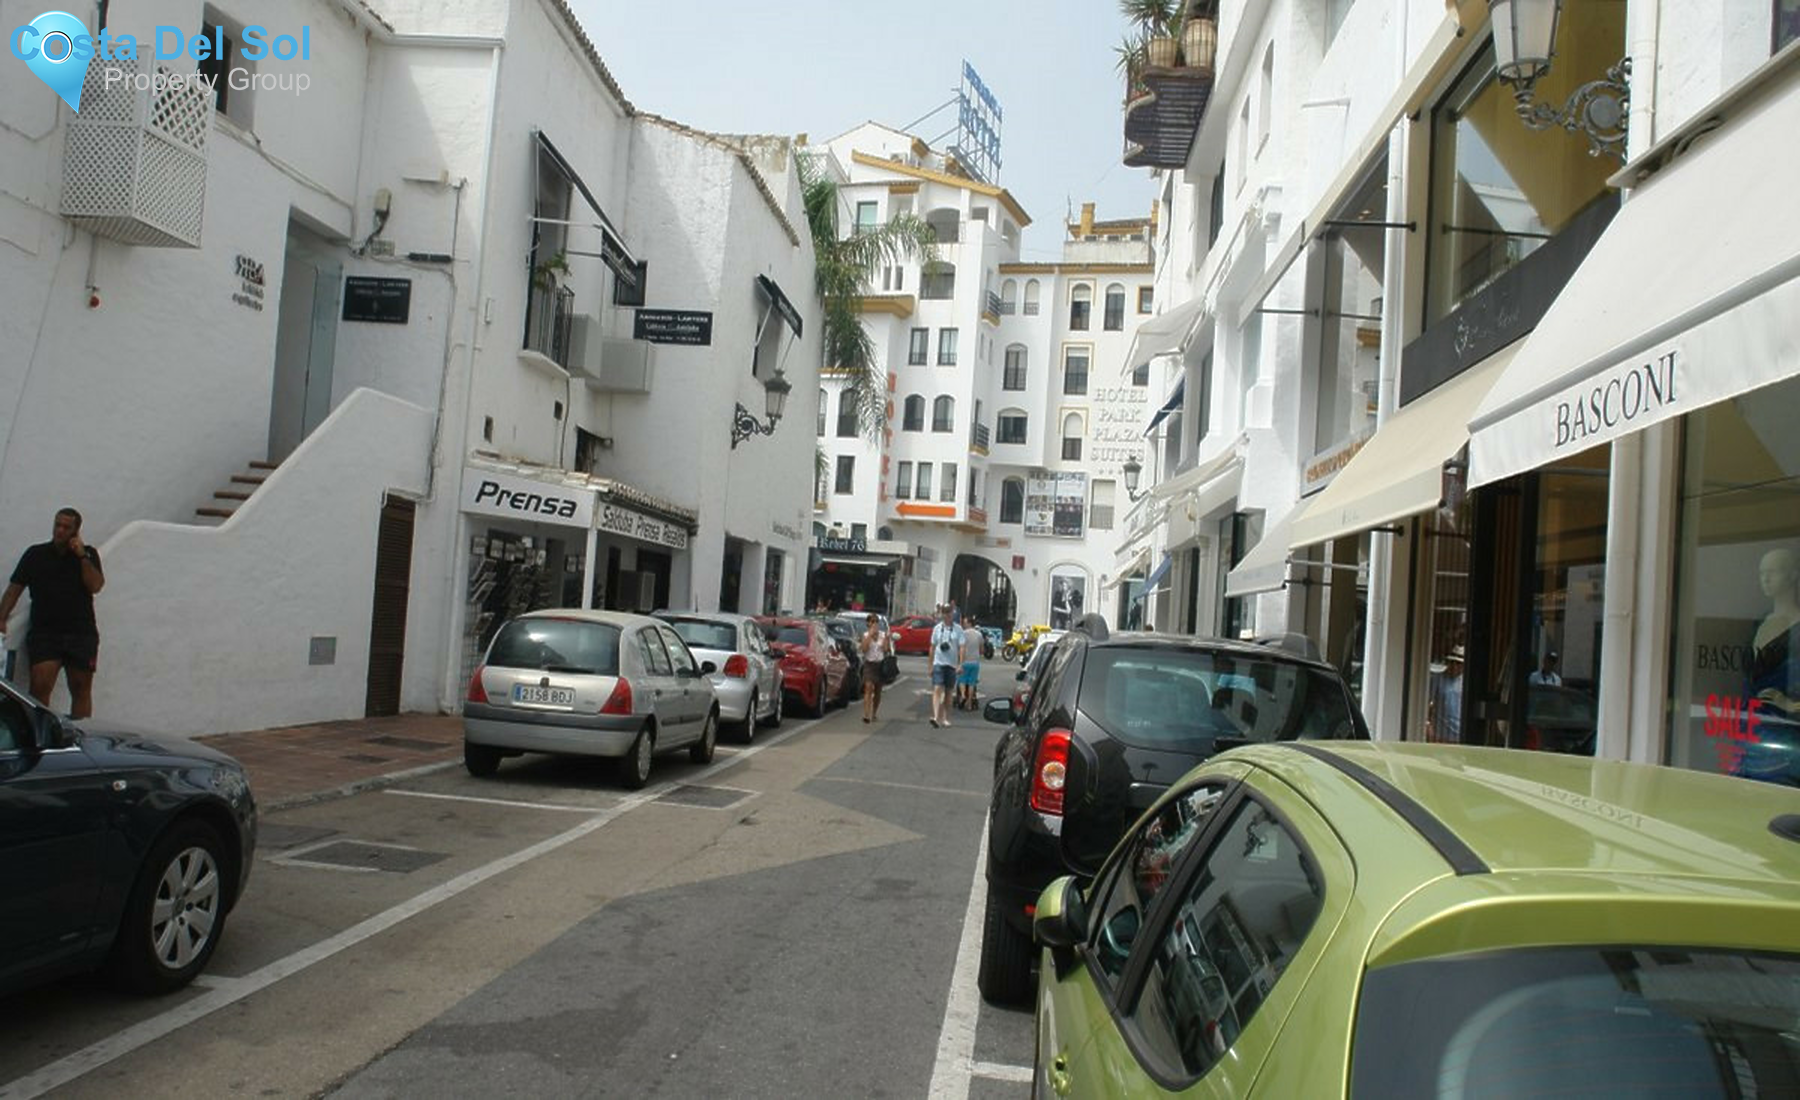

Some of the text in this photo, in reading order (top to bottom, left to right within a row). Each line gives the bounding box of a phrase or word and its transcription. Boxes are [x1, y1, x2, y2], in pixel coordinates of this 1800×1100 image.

[1094, 388, 1149, 404] HOTEL
[1554, 350, 1679, 448] BASCONI
[1098, 407, 1142, 424] PARK
[1093, 427, 1145, 444] PLAZA
[1090, 447, 1145, 463] SUITES
[475, 481, 578, 519] Prensa
[522, 688, 549, 702] 2158
[1704, 692, 1763, 744] SALE
